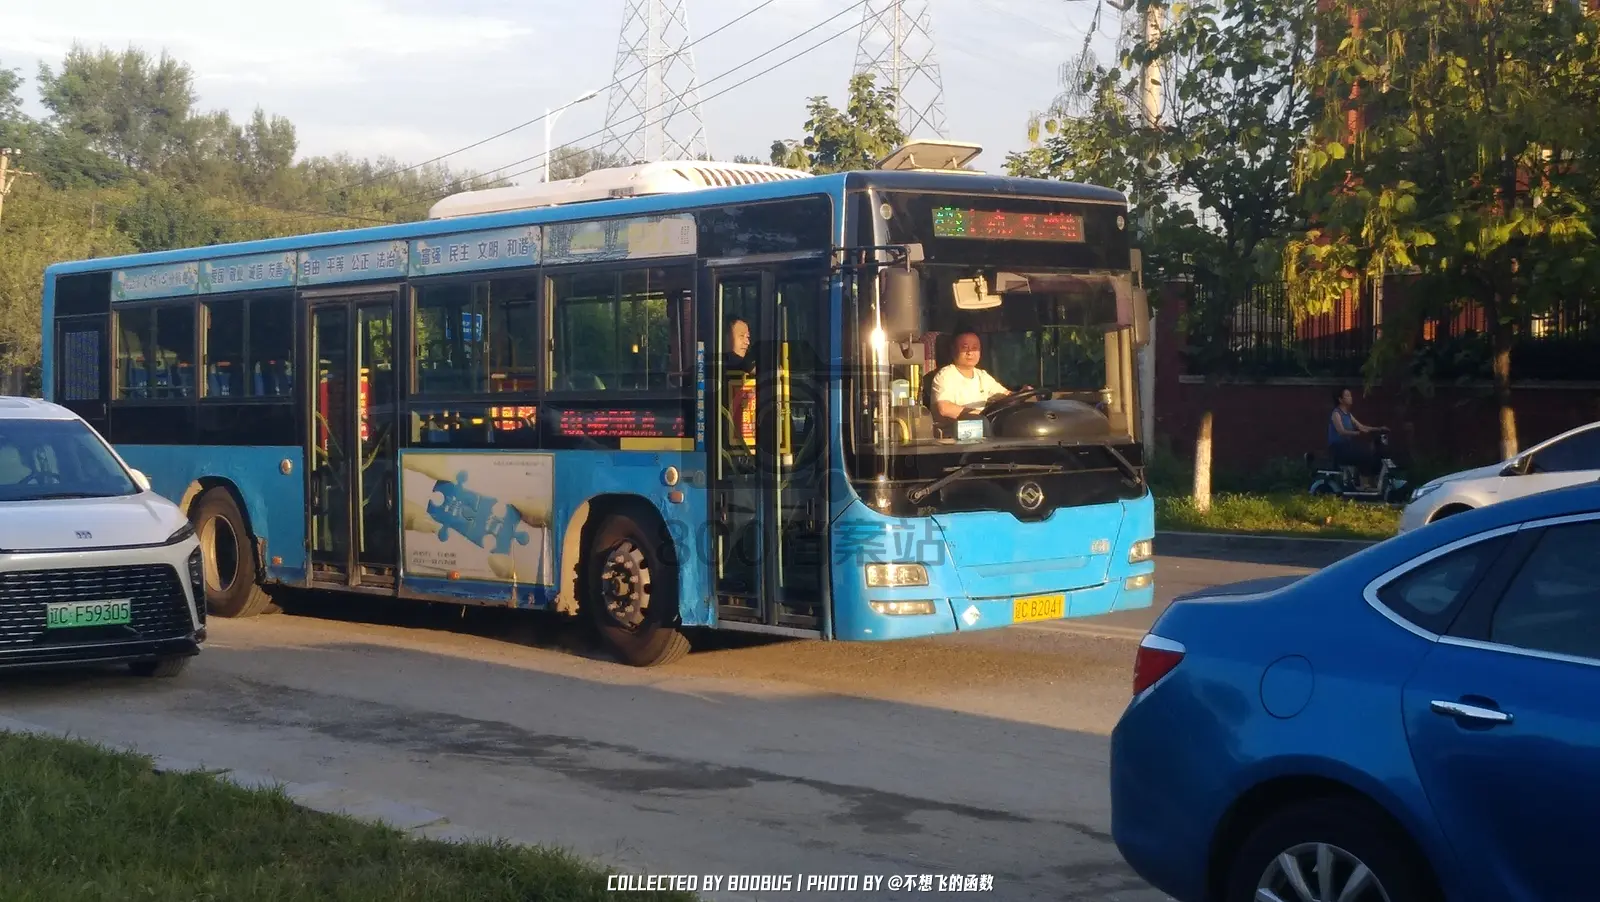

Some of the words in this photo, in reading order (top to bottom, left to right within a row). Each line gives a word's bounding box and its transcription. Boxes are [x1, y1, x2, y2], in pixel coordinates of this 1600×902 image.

[303, 259, 320, 276] 自由
[326, 255, 345, 273] 平等
[351, 253, 370, 271] 公正
[376, 250, 396, 269] 法治
[421, 246, 441, 266] 富强
[449, 245, 469, 262] 民主
[477, 240, 498, 260] 文明
[507, 237, 529, 256] 和谐
